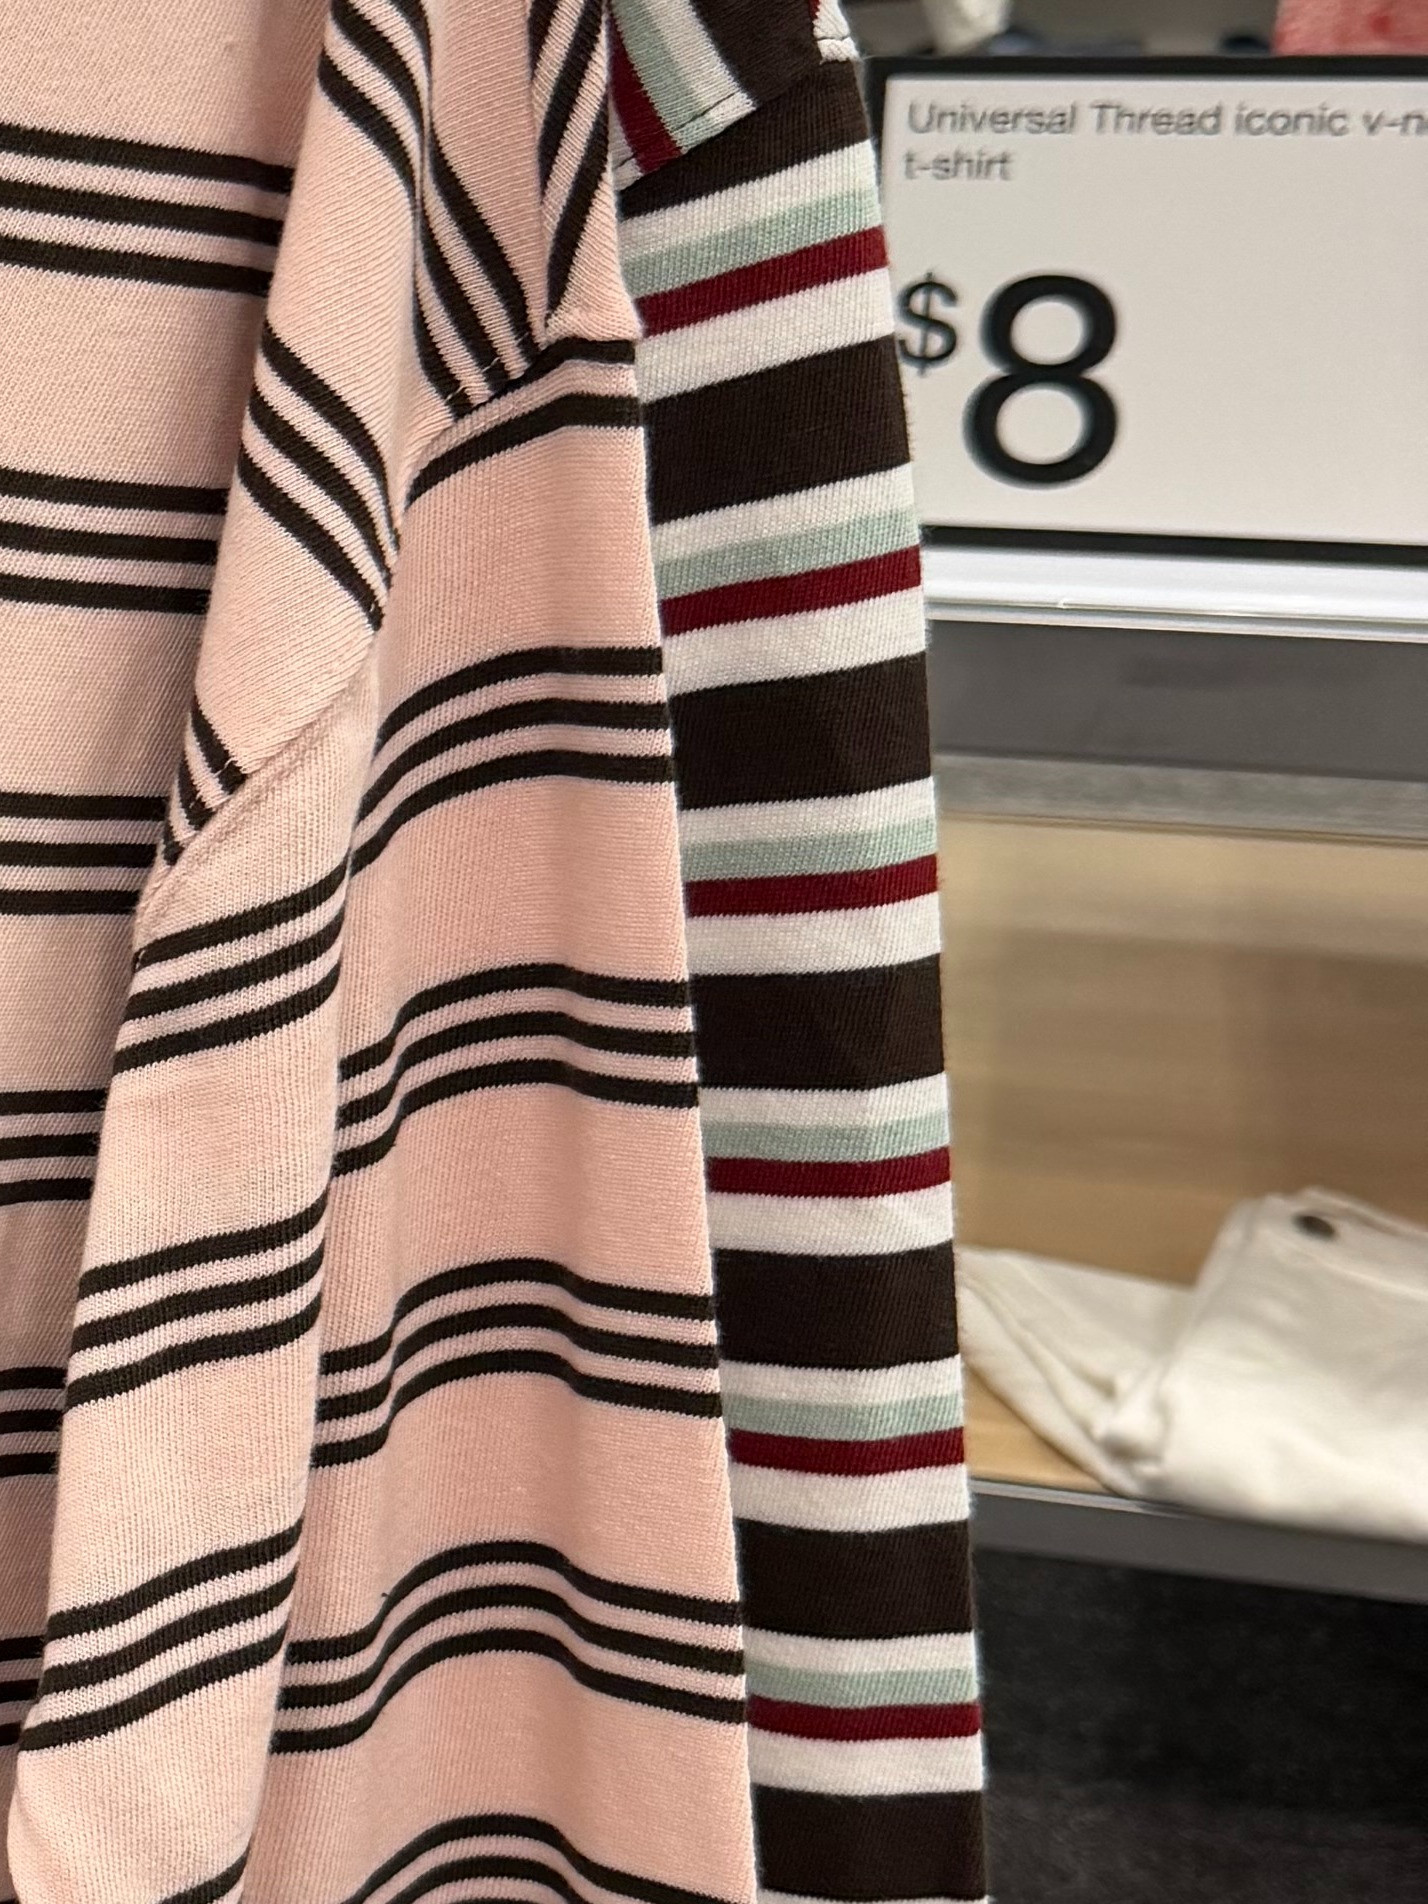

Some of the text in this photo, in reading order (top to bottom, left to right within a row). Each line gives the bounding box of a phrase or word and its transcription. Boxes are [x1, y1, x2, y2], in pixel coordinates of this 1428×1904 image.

[906, 101, 1428, 137] Universal Thread iconic v-n
[903, 148, 1013, 182] t-shirt
